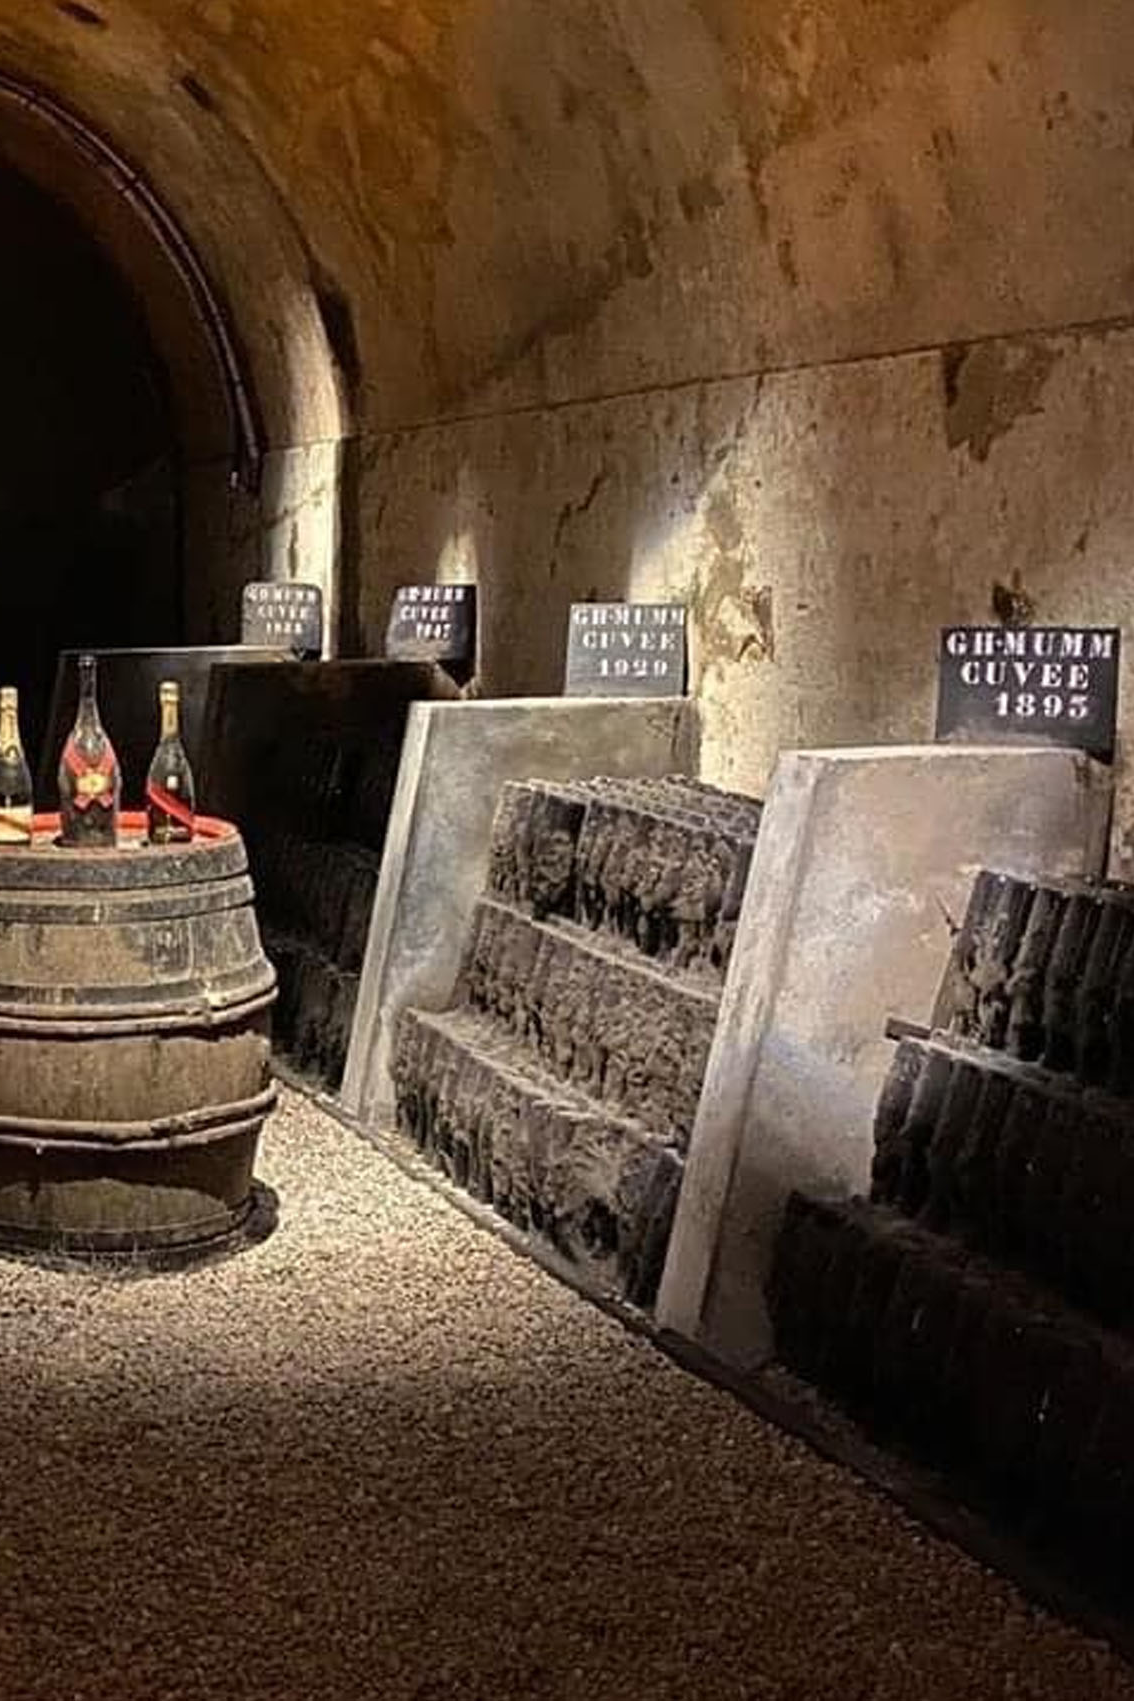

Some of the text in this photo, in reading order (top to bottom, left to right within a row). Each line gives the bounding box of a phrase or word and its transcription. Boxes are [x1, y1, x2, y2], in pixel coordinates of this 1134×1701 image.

[582, 631, 676, 650] CUVEE
[960, 661, 1090, 690] CUVEE
[996, 692, 1089, 719] 1895
